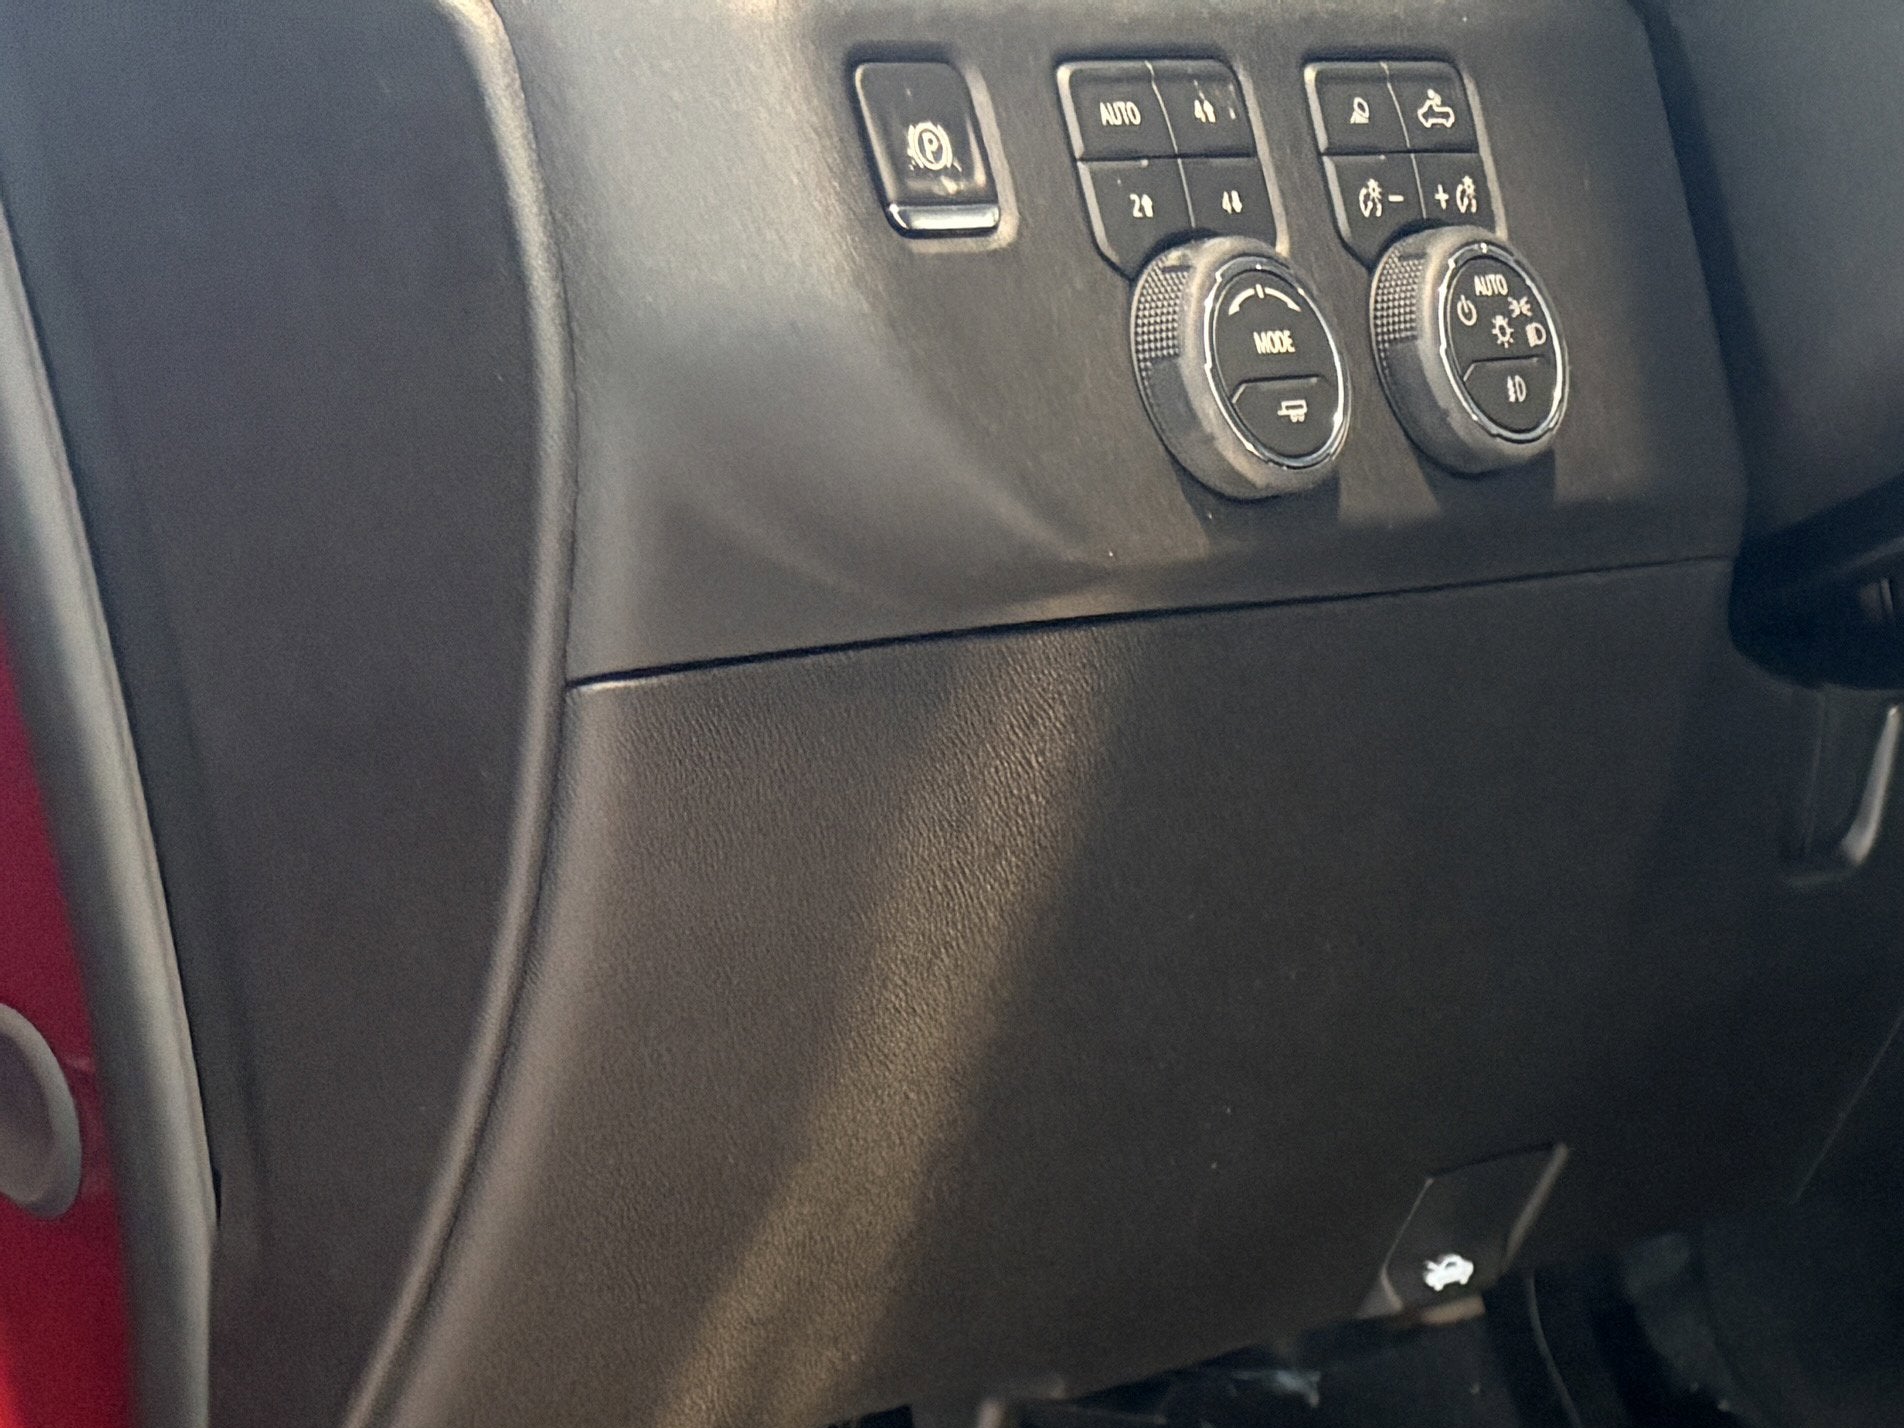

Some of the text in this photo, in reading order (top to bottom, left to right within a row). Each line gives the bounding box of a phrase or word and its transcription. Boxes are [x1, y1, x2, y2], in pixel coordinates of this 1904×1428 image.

[1100, 101, 1141, 126] AUTO
[1474, 274, 1508, 296] AUTO
[1253, 329, 1296, 354] MODE
